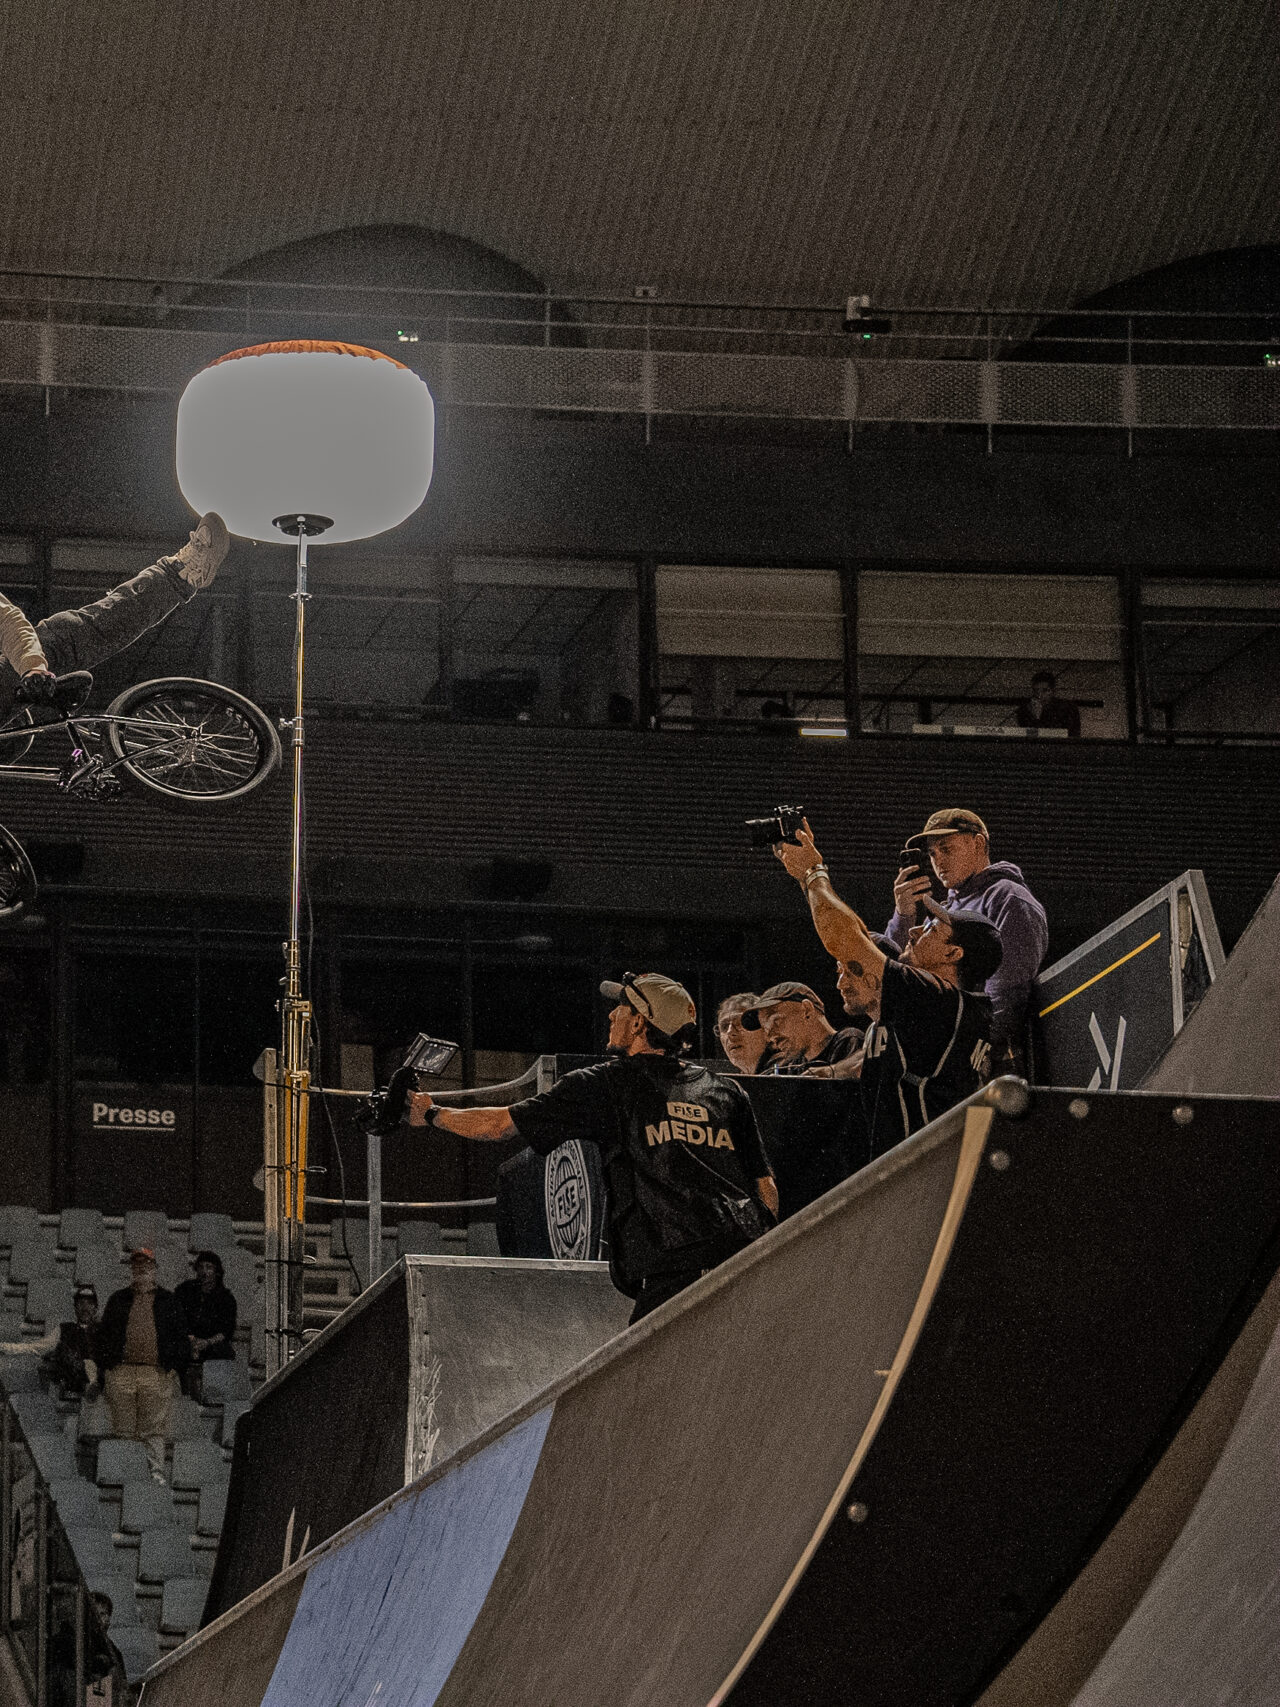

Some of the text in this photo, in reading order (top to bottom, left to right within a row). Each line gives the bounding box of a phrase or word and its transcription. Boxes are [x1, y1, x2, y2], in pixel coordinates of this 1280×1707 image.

[93, 1103, 175, 1125] Presse
[674, 1105, 702, 1118] FISE
[645, 1120, 735, 1151] MEDIA
[557, 1184, 576, 1219] FISE
